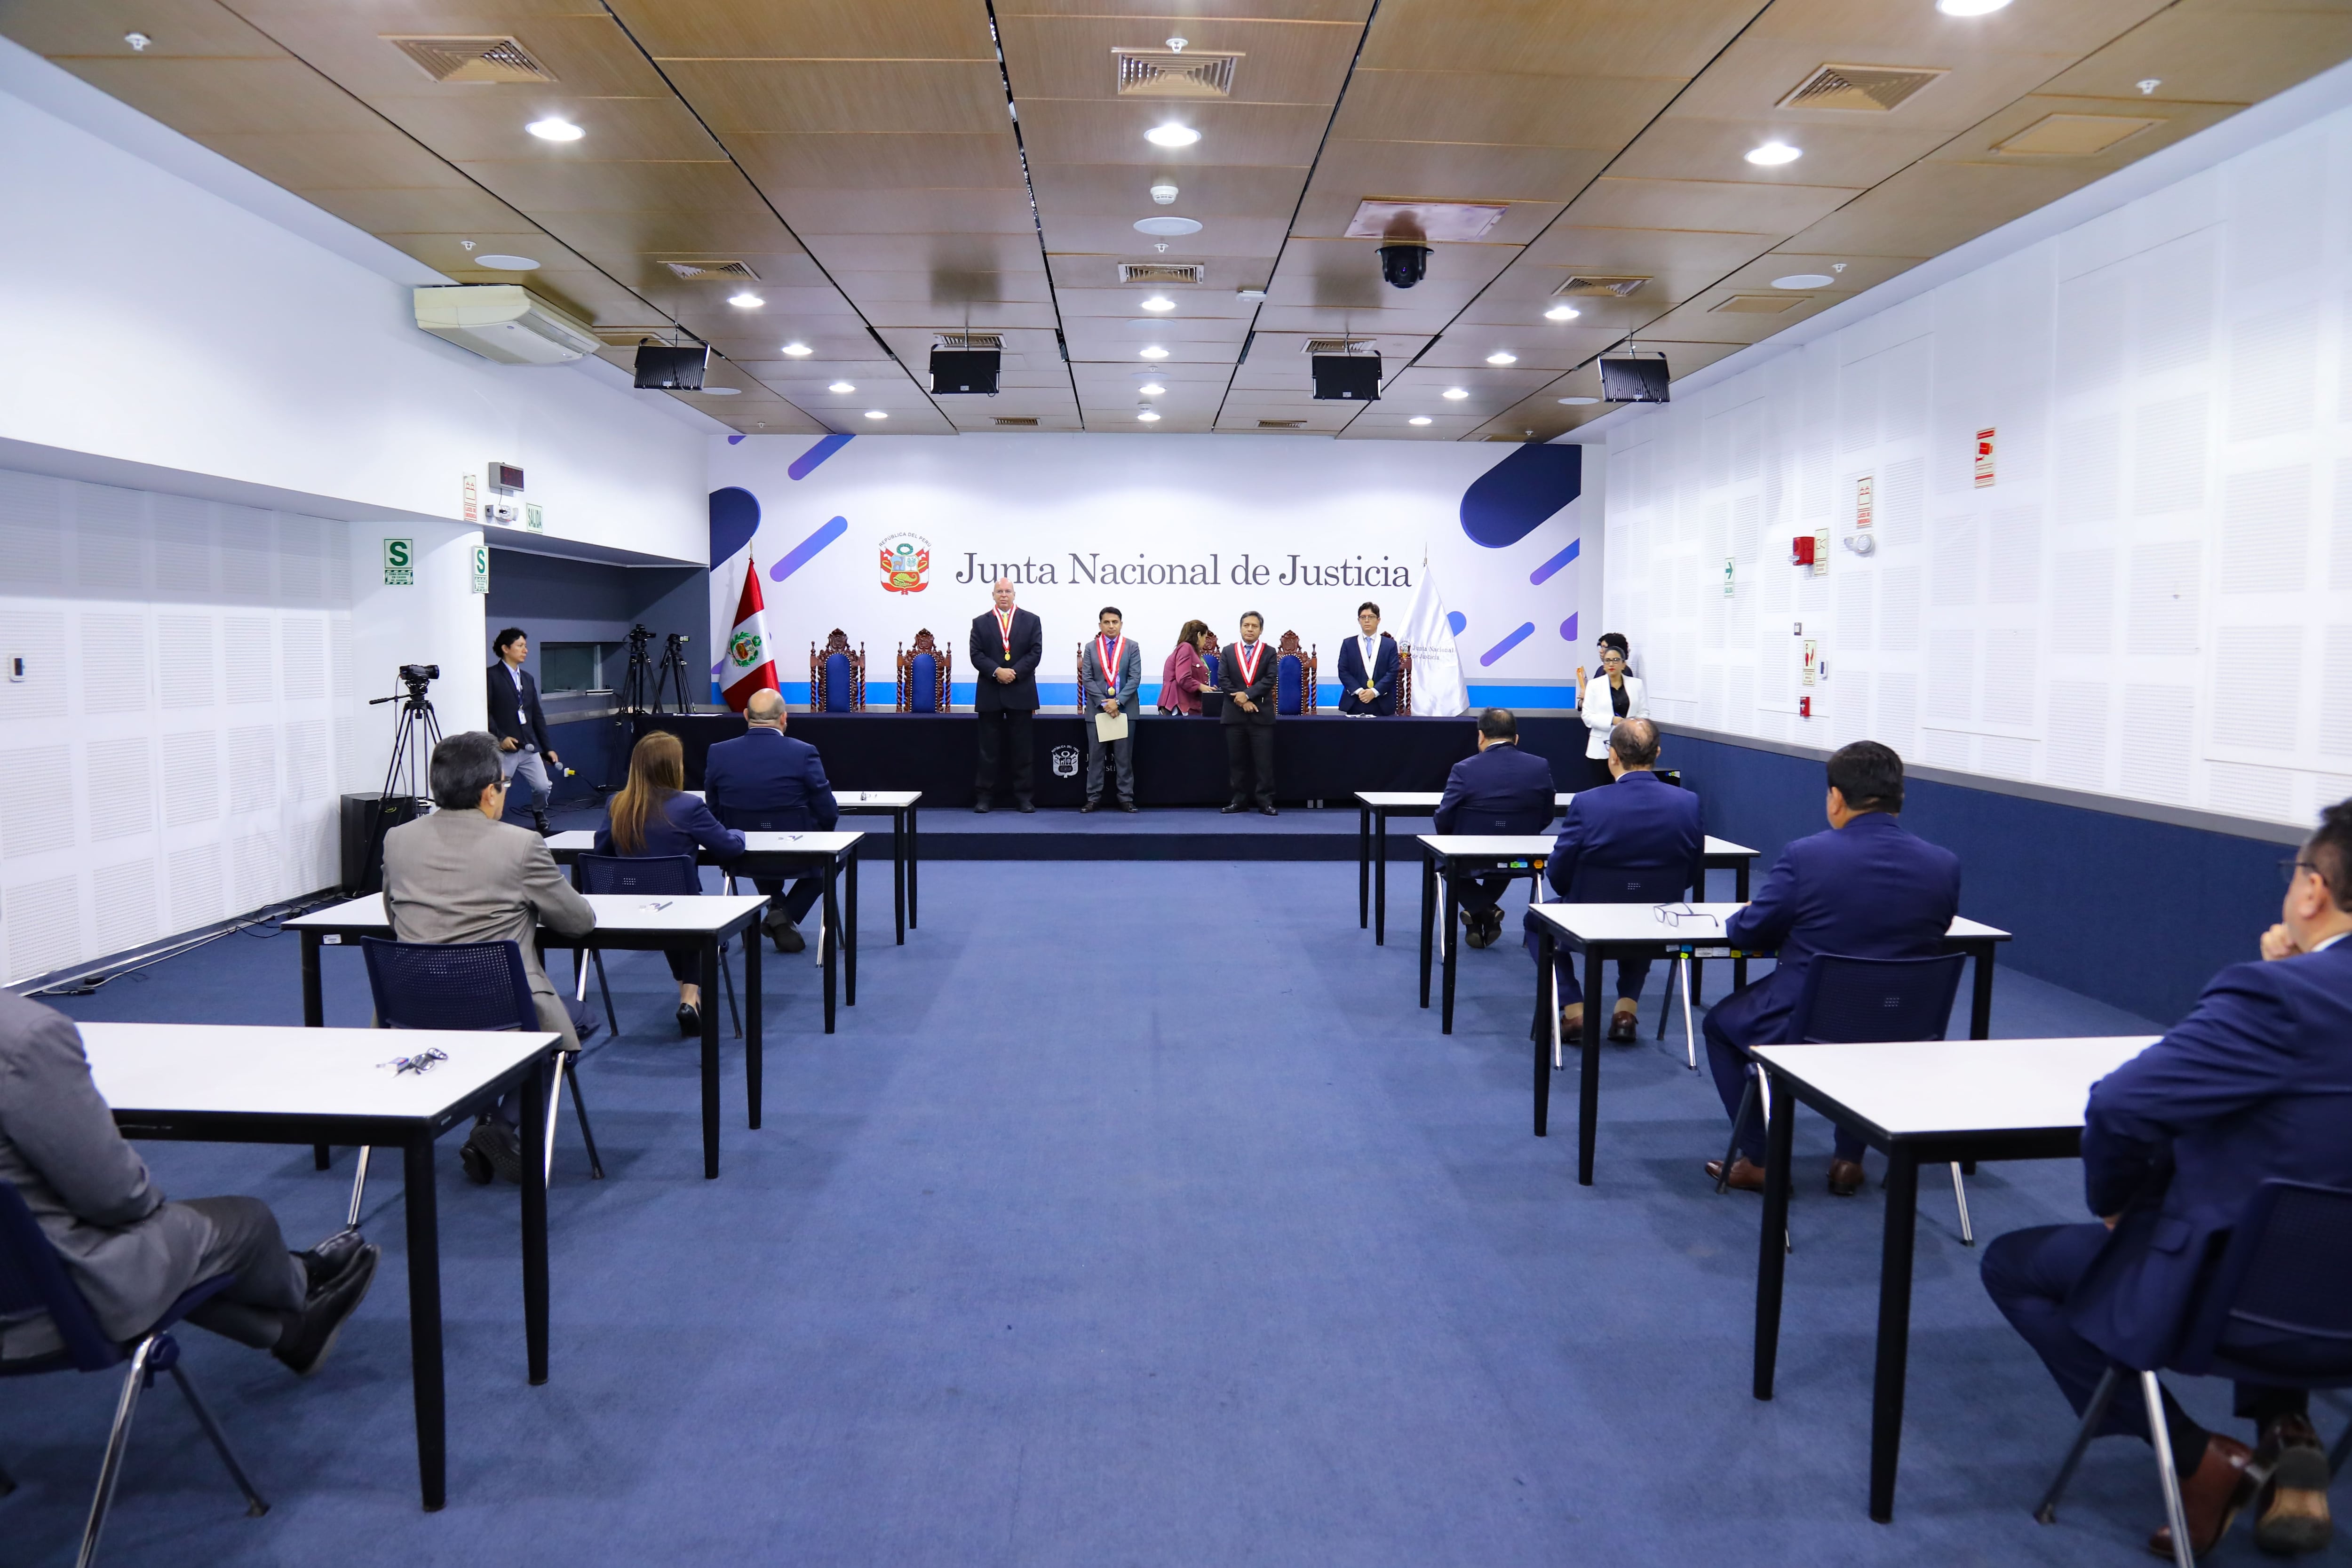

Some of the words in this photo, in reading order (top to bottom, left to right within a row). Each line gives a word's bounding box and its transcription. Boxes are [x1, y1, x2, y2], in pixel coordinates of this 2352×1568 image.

[528, 508, 541, 528] SALIDA
[878, 532, 906, 547] REPÚBLICA
[918, 536, 932, 547] PERÚ
[389, 541, 408, 566] S
[477, 549, 485, 573] S
[955, 552, 1057, 584] Junta
[1068, 553, 1221, 585] Nacional
[1231, 554, 1270, 585] de
[1279, 555, 1412, 587] Justicia
